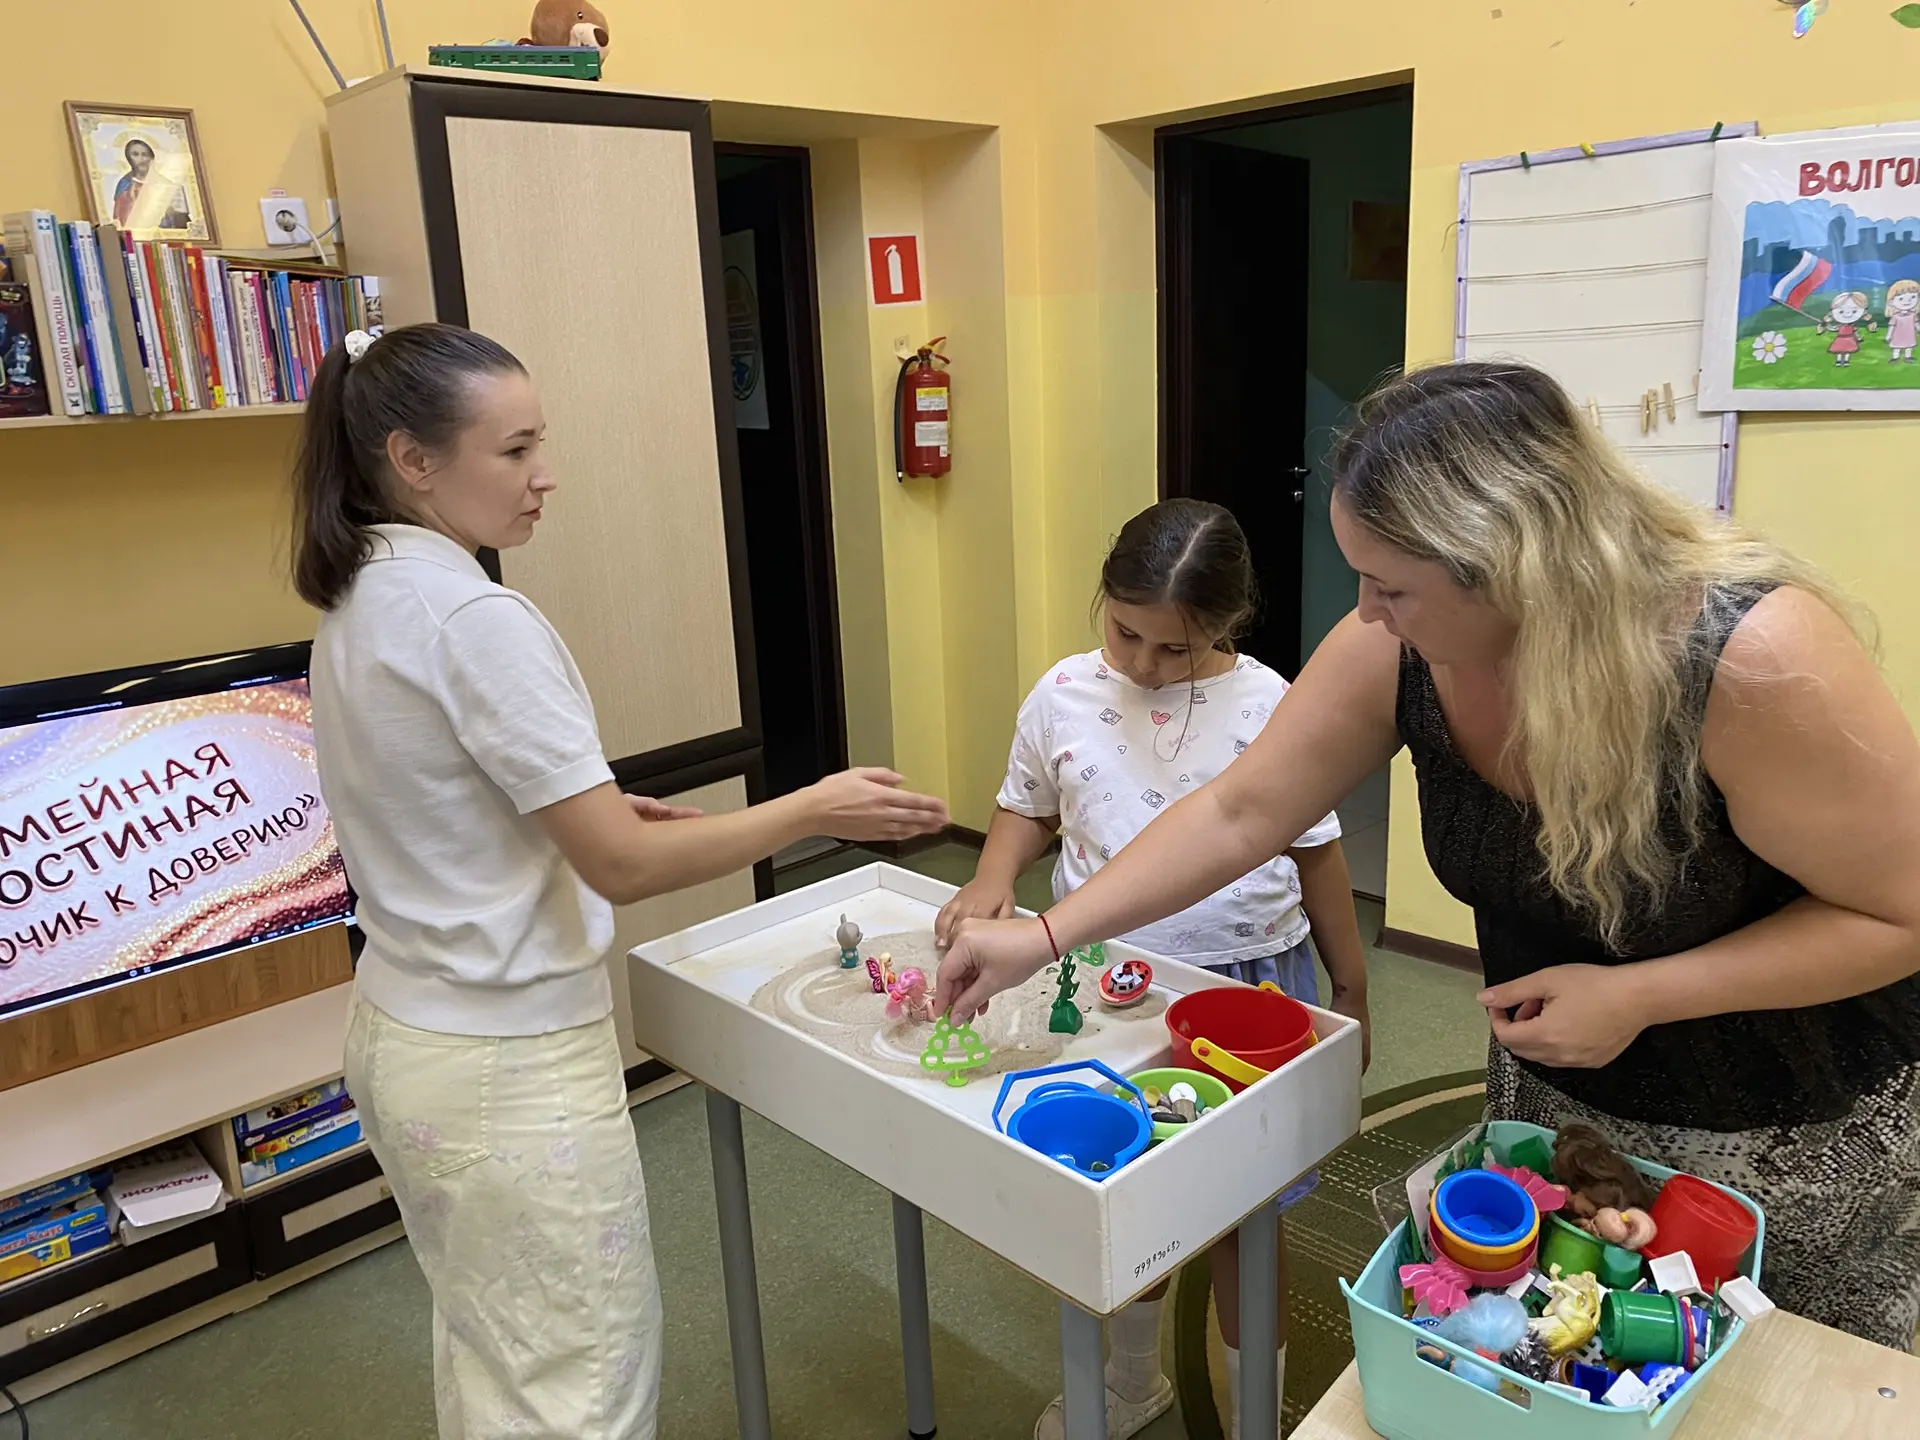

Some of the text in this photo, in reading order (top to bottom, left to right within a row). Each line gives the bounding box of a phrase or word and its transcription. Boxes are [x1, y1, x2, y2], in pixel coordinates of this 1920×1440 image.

[1798, 157, 1920, 197] ВОЛГО
[52, 295, 69, 345] ПОМОЩЬ
[60, 346, 76, 389] СКОРАЯ
[0, 742, 232, 857] МЕЙНАЯ
[0, 778, 251, 905] ОСТИНАЯ
[104, 884, 135, 912] К
[148, 793, 318, 901] ДОВЕРИЮ»
